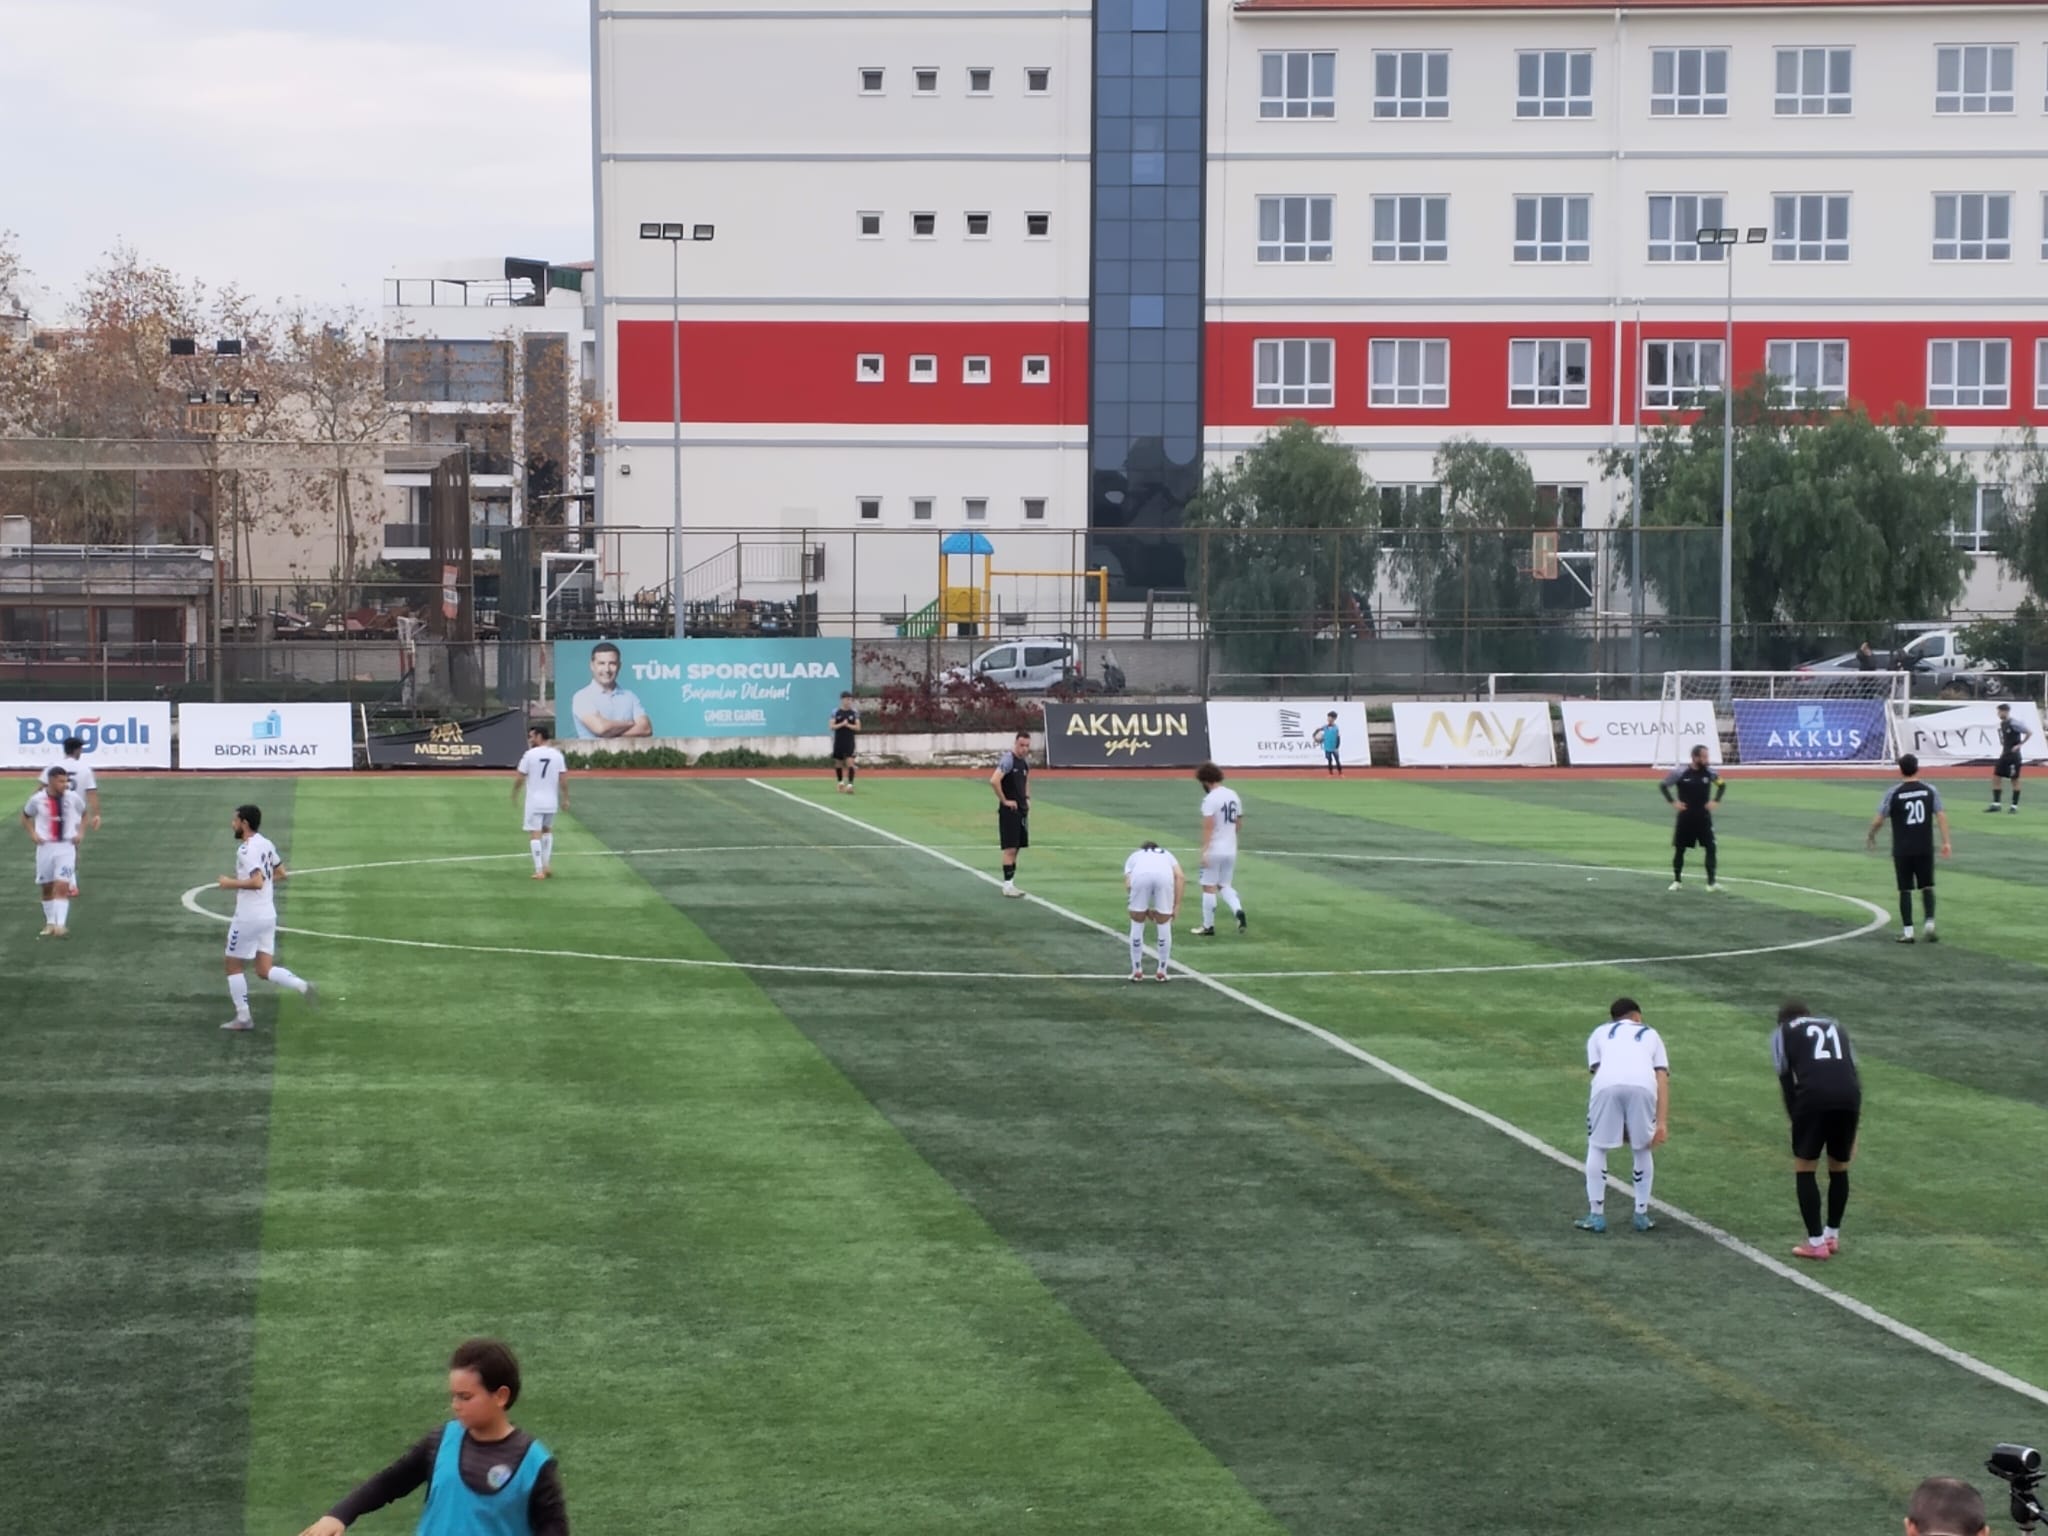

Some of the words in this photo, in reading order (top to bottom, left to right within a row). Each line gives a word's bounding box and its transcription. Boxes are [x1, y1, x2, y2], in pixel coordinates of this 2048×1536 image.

[632, 661, 681, 680] TÜM
[687, 662, 840, 679] SPORCULARA
[16, 716, 149, 753] Boğalı
[1066, 713, 1188, 736] AKMUN
[414, 743, 483, 755] MEDSER
[1257, 741, 1294, 752] ERTAŞ
[539, 758, 551, 779] 7
[1220, 800, 1238, 824] 16
[1905, 799, 1926, 825] 20
[1806, 1024, 1843, 1060] 21
